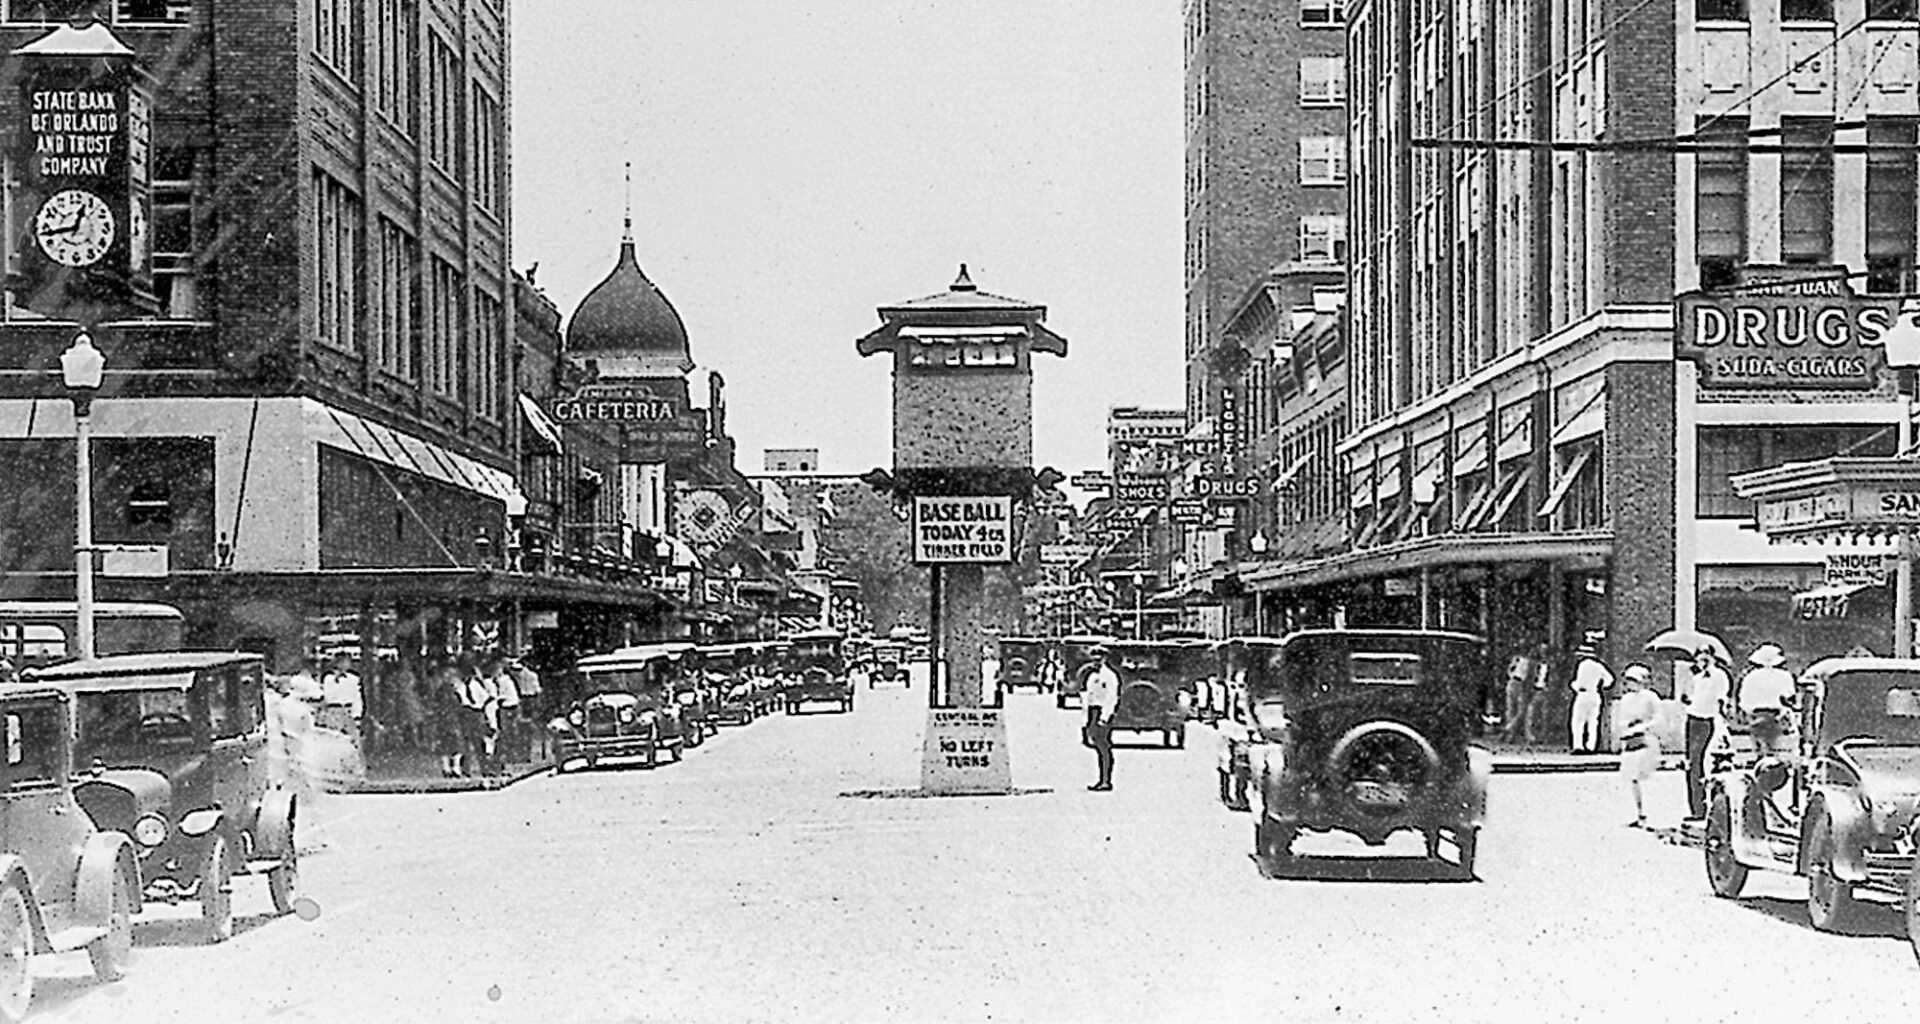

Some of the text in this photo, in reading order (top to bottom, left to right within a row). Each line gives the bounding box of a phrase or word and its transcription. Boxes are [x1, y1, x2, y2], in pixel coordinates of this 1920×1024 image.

[33, 91, 116, 110] STATE BANK
[53, 113, 118, 132] ORLANDO
[36, 135, 114, 153] AND TRUST
[40, 157, 108, 176] COMPANY
[1790, 279, 1841, 297] JUAN
[1696, 306, 1890, 347] DRUGS
[555, 402, 674, 420] CAFETERIA
[1118, 487, 1166, 499] SHOES
[1199, 479, 1260, 495] DRUGS
[920, 524, 975, 541] TODAY
[969, 543, 1004, 558] FIELD
[1827, 569, 1885, 582] PARKING
[939, 740, 994, 753] NO LEFT
[945, 755, 990, 769] TURNS
